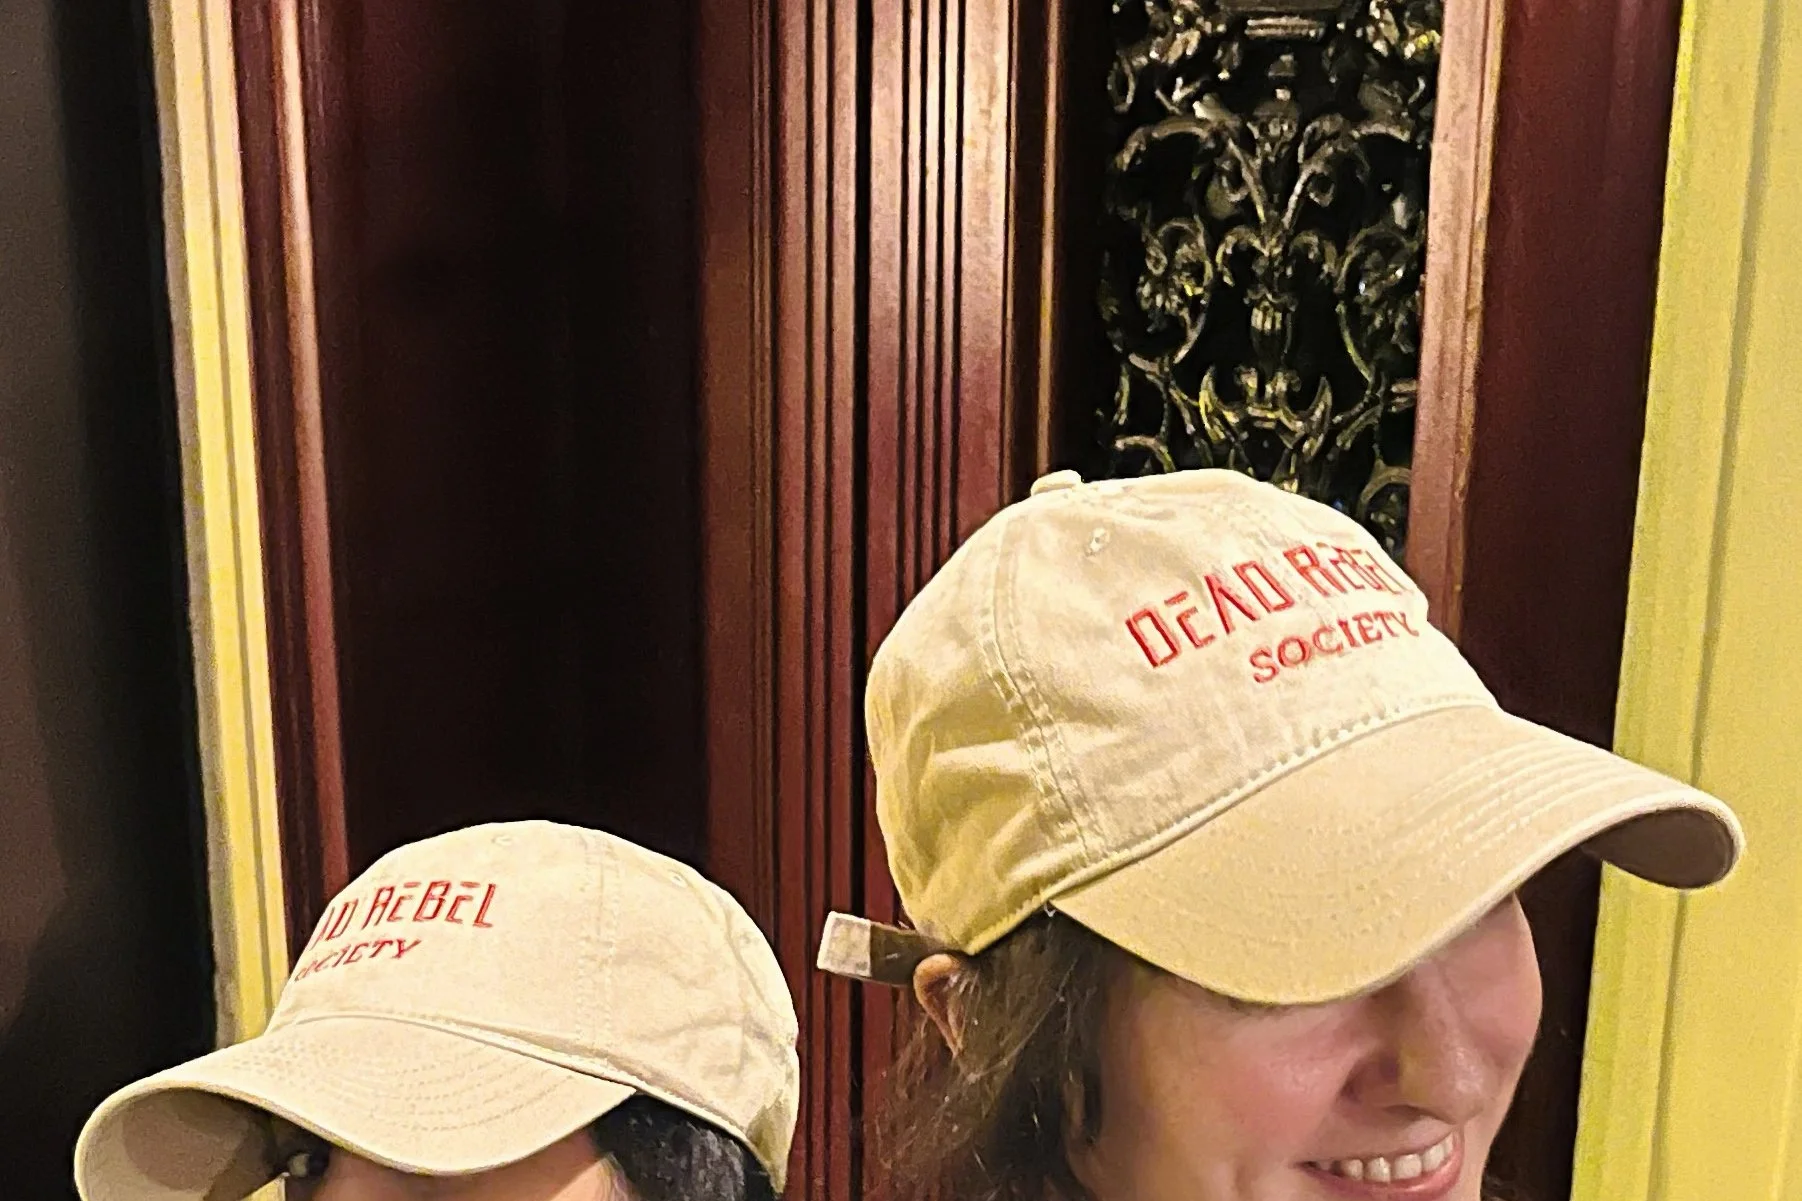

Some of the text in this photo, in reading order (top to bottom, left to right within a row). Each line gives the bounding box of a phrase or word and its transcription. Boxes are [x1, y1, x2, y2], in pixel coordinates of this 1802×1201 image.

[1125, 560, 1296, 668] DEAD
[1249, 611, 1420, 683] SOCIETY
[361, 880, 497, 929] REBEL
[294, 938, 422, 982] OCIETY
